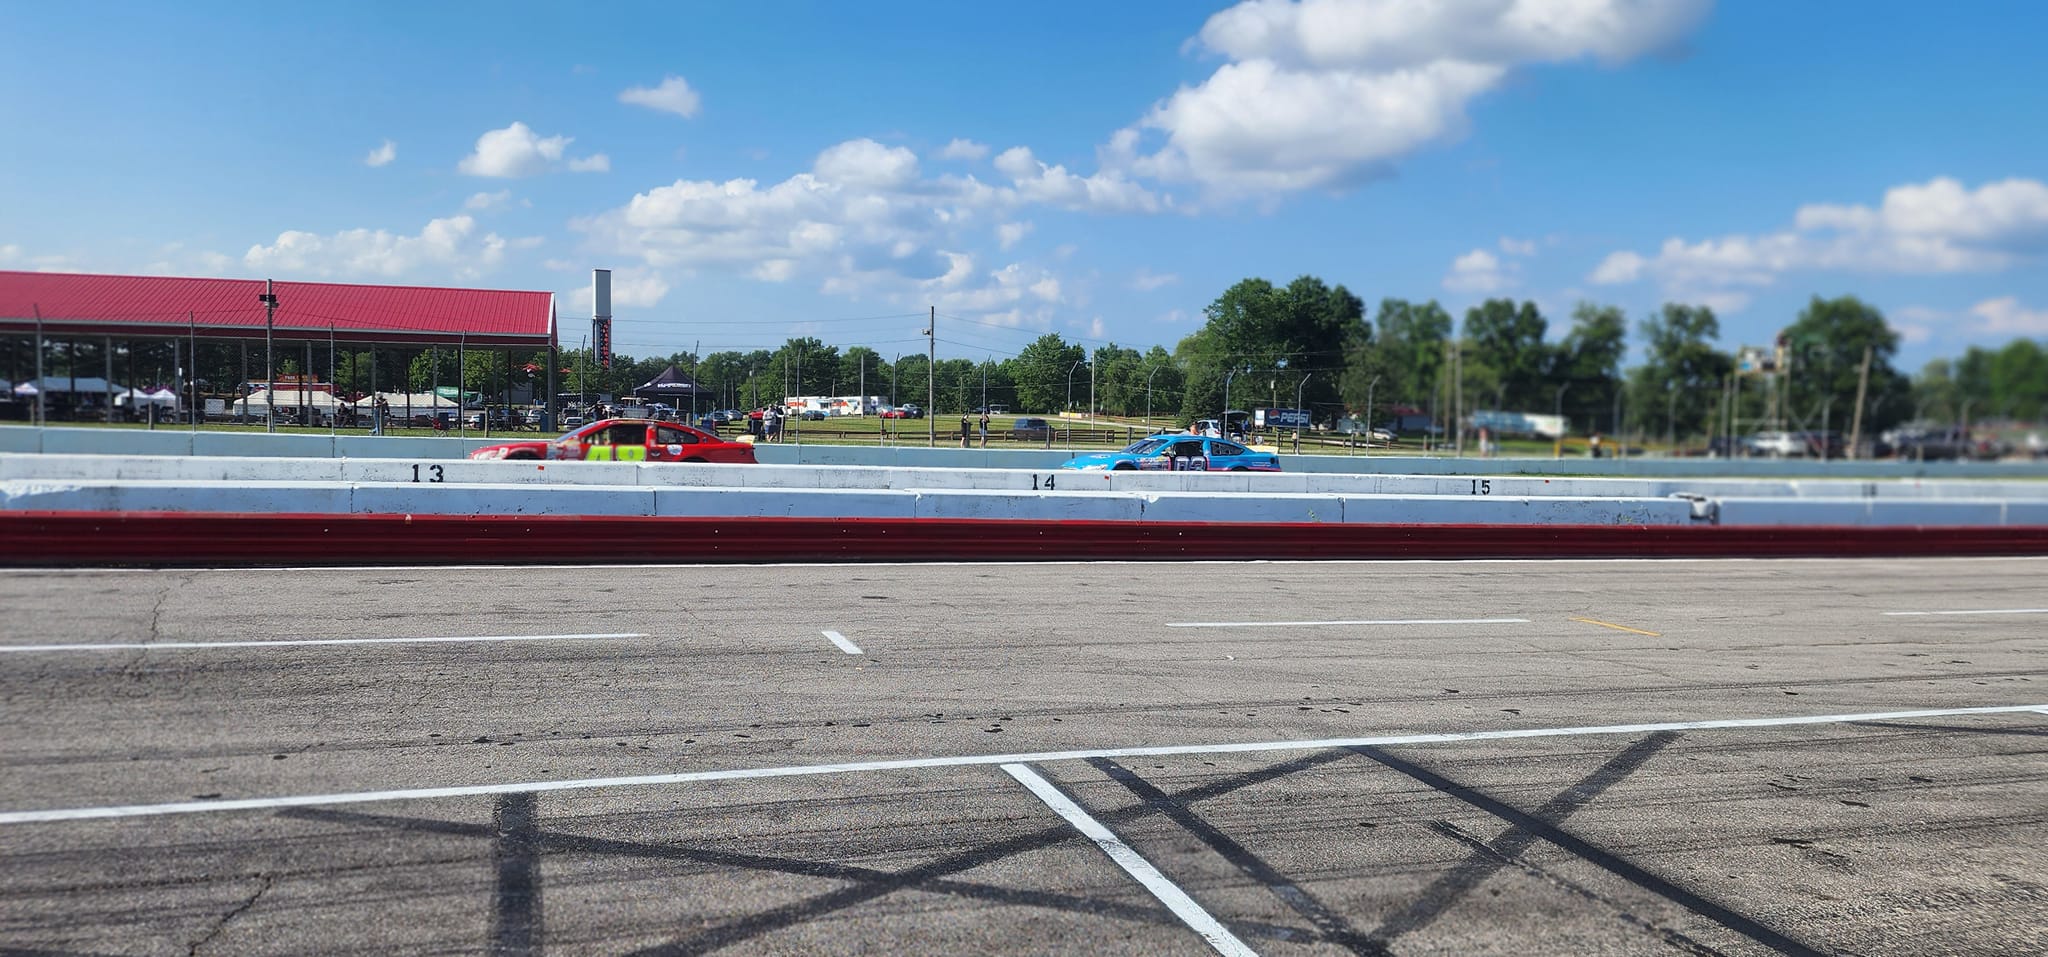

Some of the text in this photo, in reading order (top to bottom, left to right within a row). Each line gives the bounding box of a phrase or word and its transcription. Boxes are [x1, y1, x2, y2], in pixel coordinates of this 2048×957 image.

[1280, 412, 1309, 424] PEPSI
[412, 463, 444, 483] 13
[1032, 474, 1055, 491] 14
[1471, 479, 1491, 495] 15
